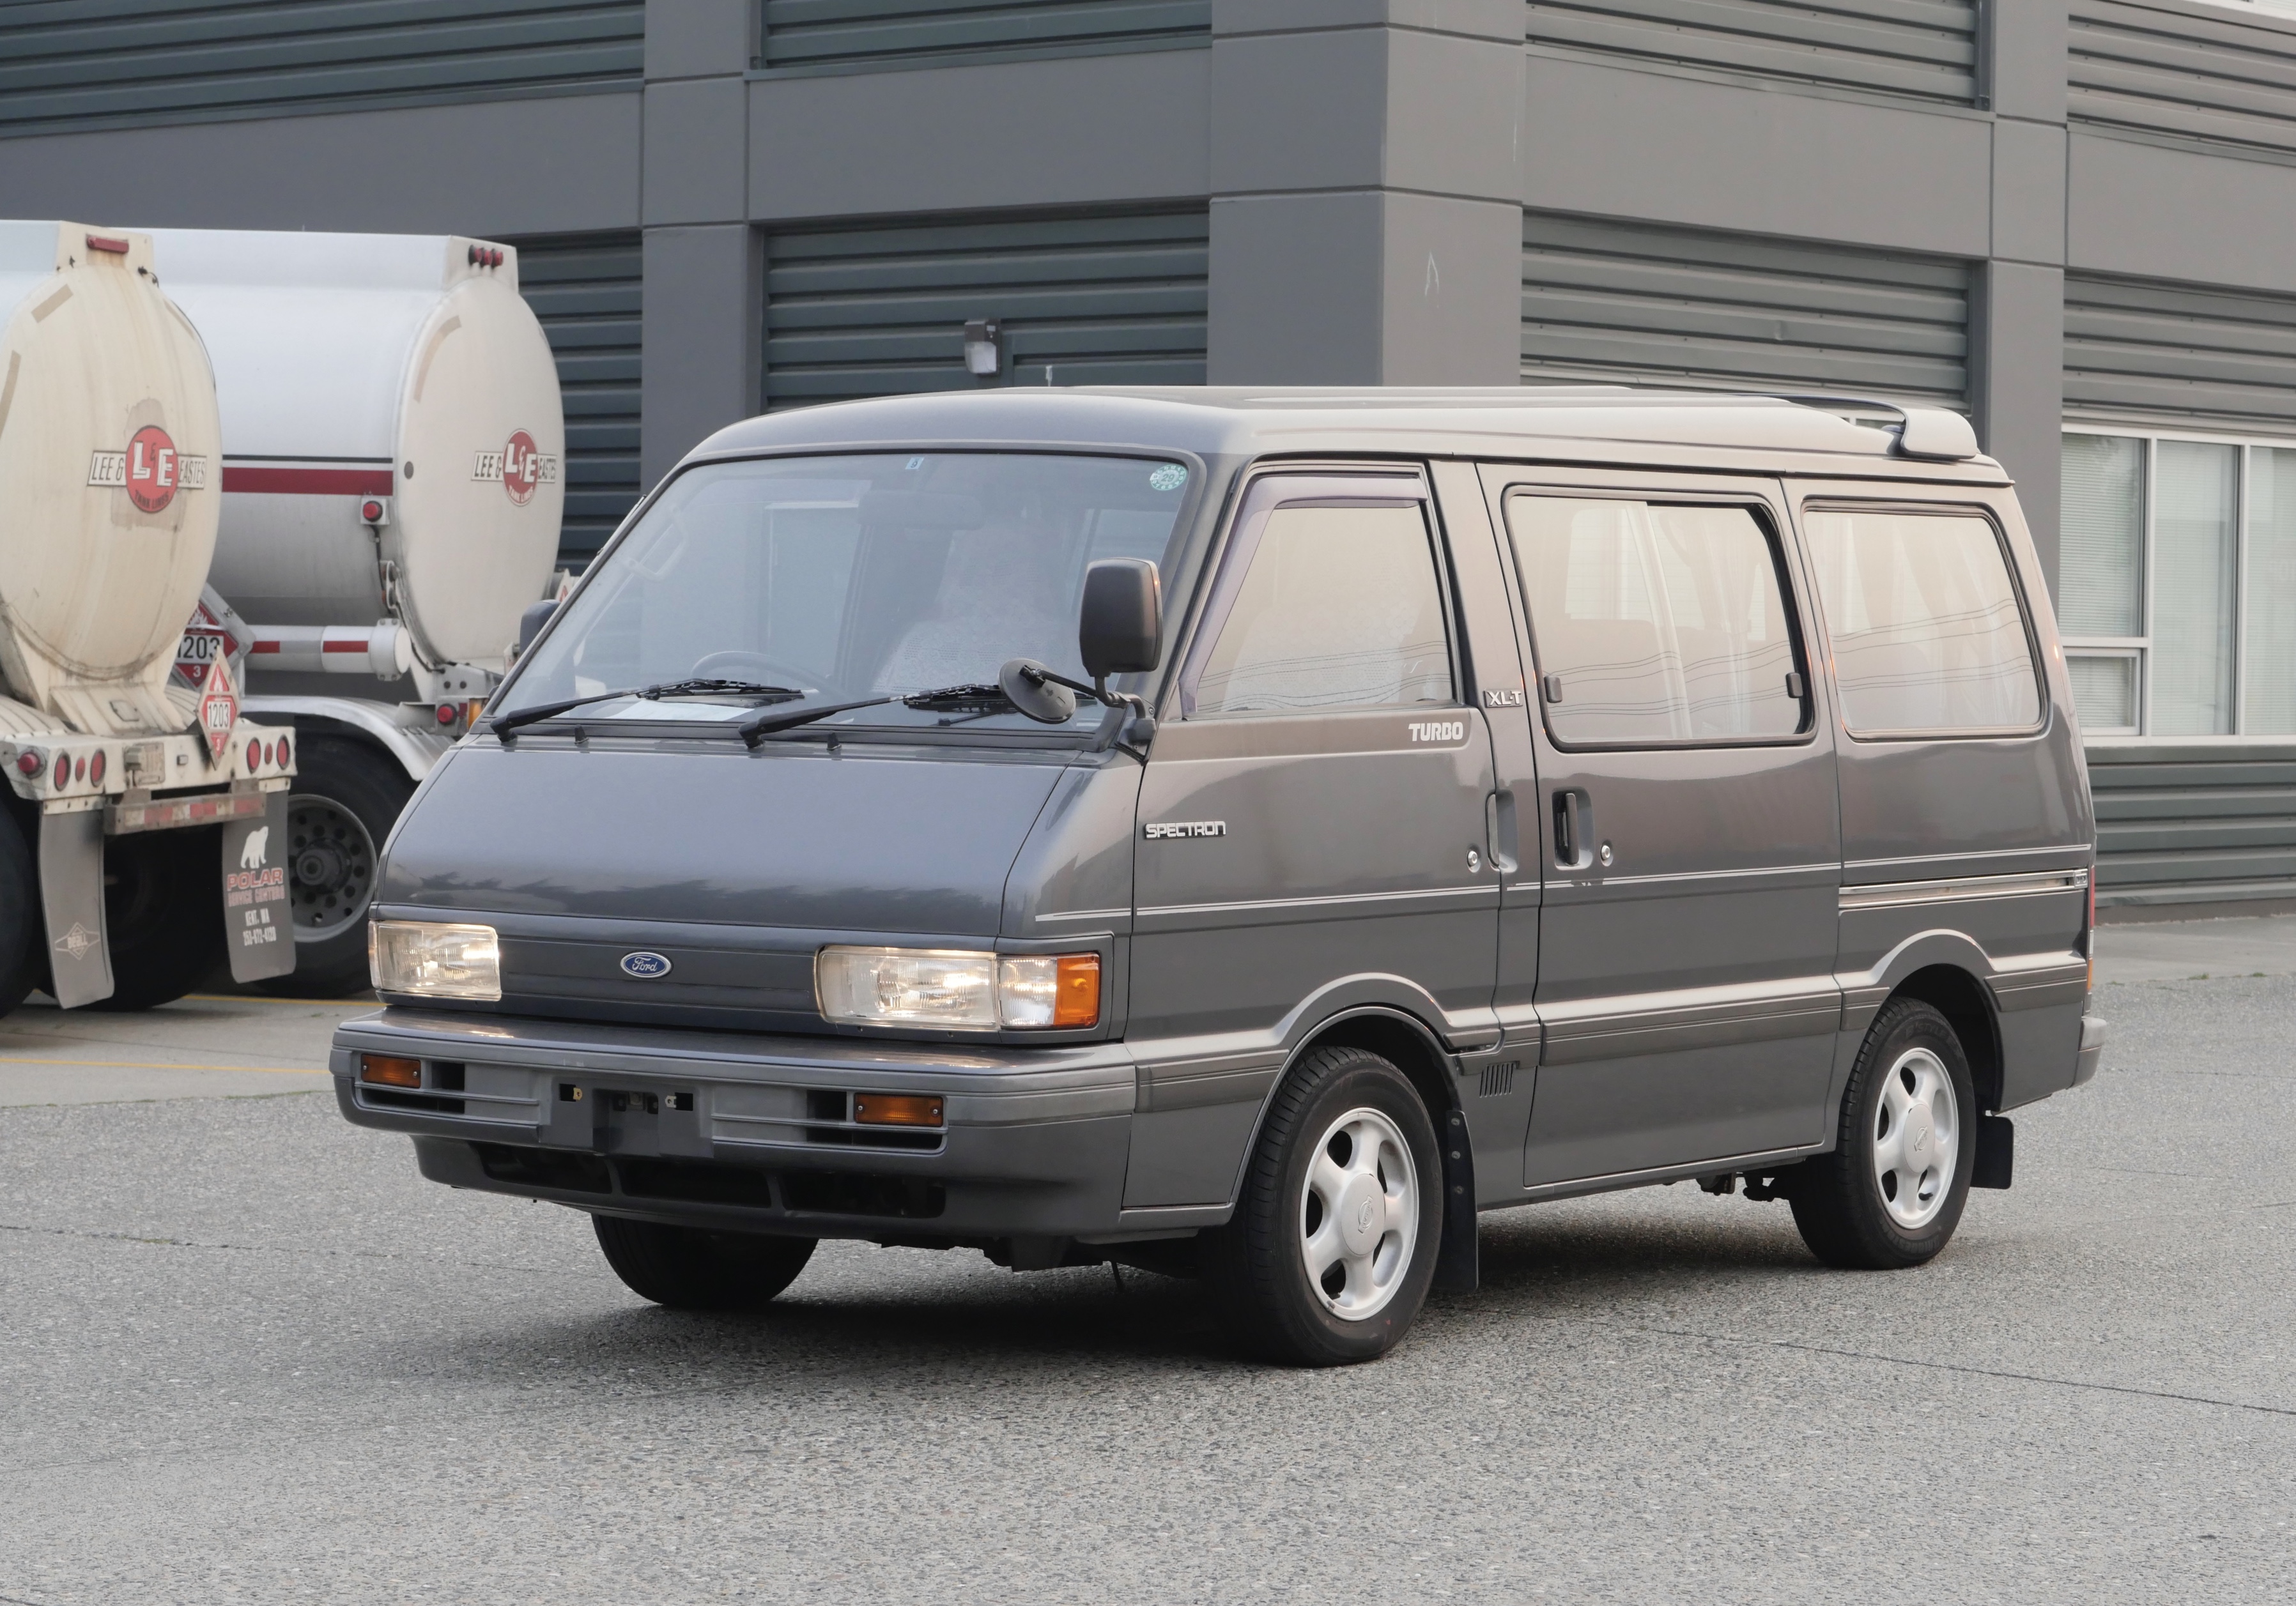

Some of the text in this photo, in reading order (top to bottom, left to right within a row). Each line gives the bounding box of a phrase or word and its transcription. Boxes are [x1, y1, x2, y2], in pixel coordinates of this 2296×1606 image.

[91, 457, 205, 484] LEE & EASTES
[474, 455, 494, 478] LEE
[495, 455, 502, 479] &
[1162, 474, 1175, 482] 29
[193, 665, 201, 677] 3
[209, 704, 229, 727] 1203
[1408, 721, 1463, 742] TURBO
[1146, 821, 1226, 838] SPECTRON
[227, 868, 283, 891] POLAR
[632, 957, 658, 972] Ford
